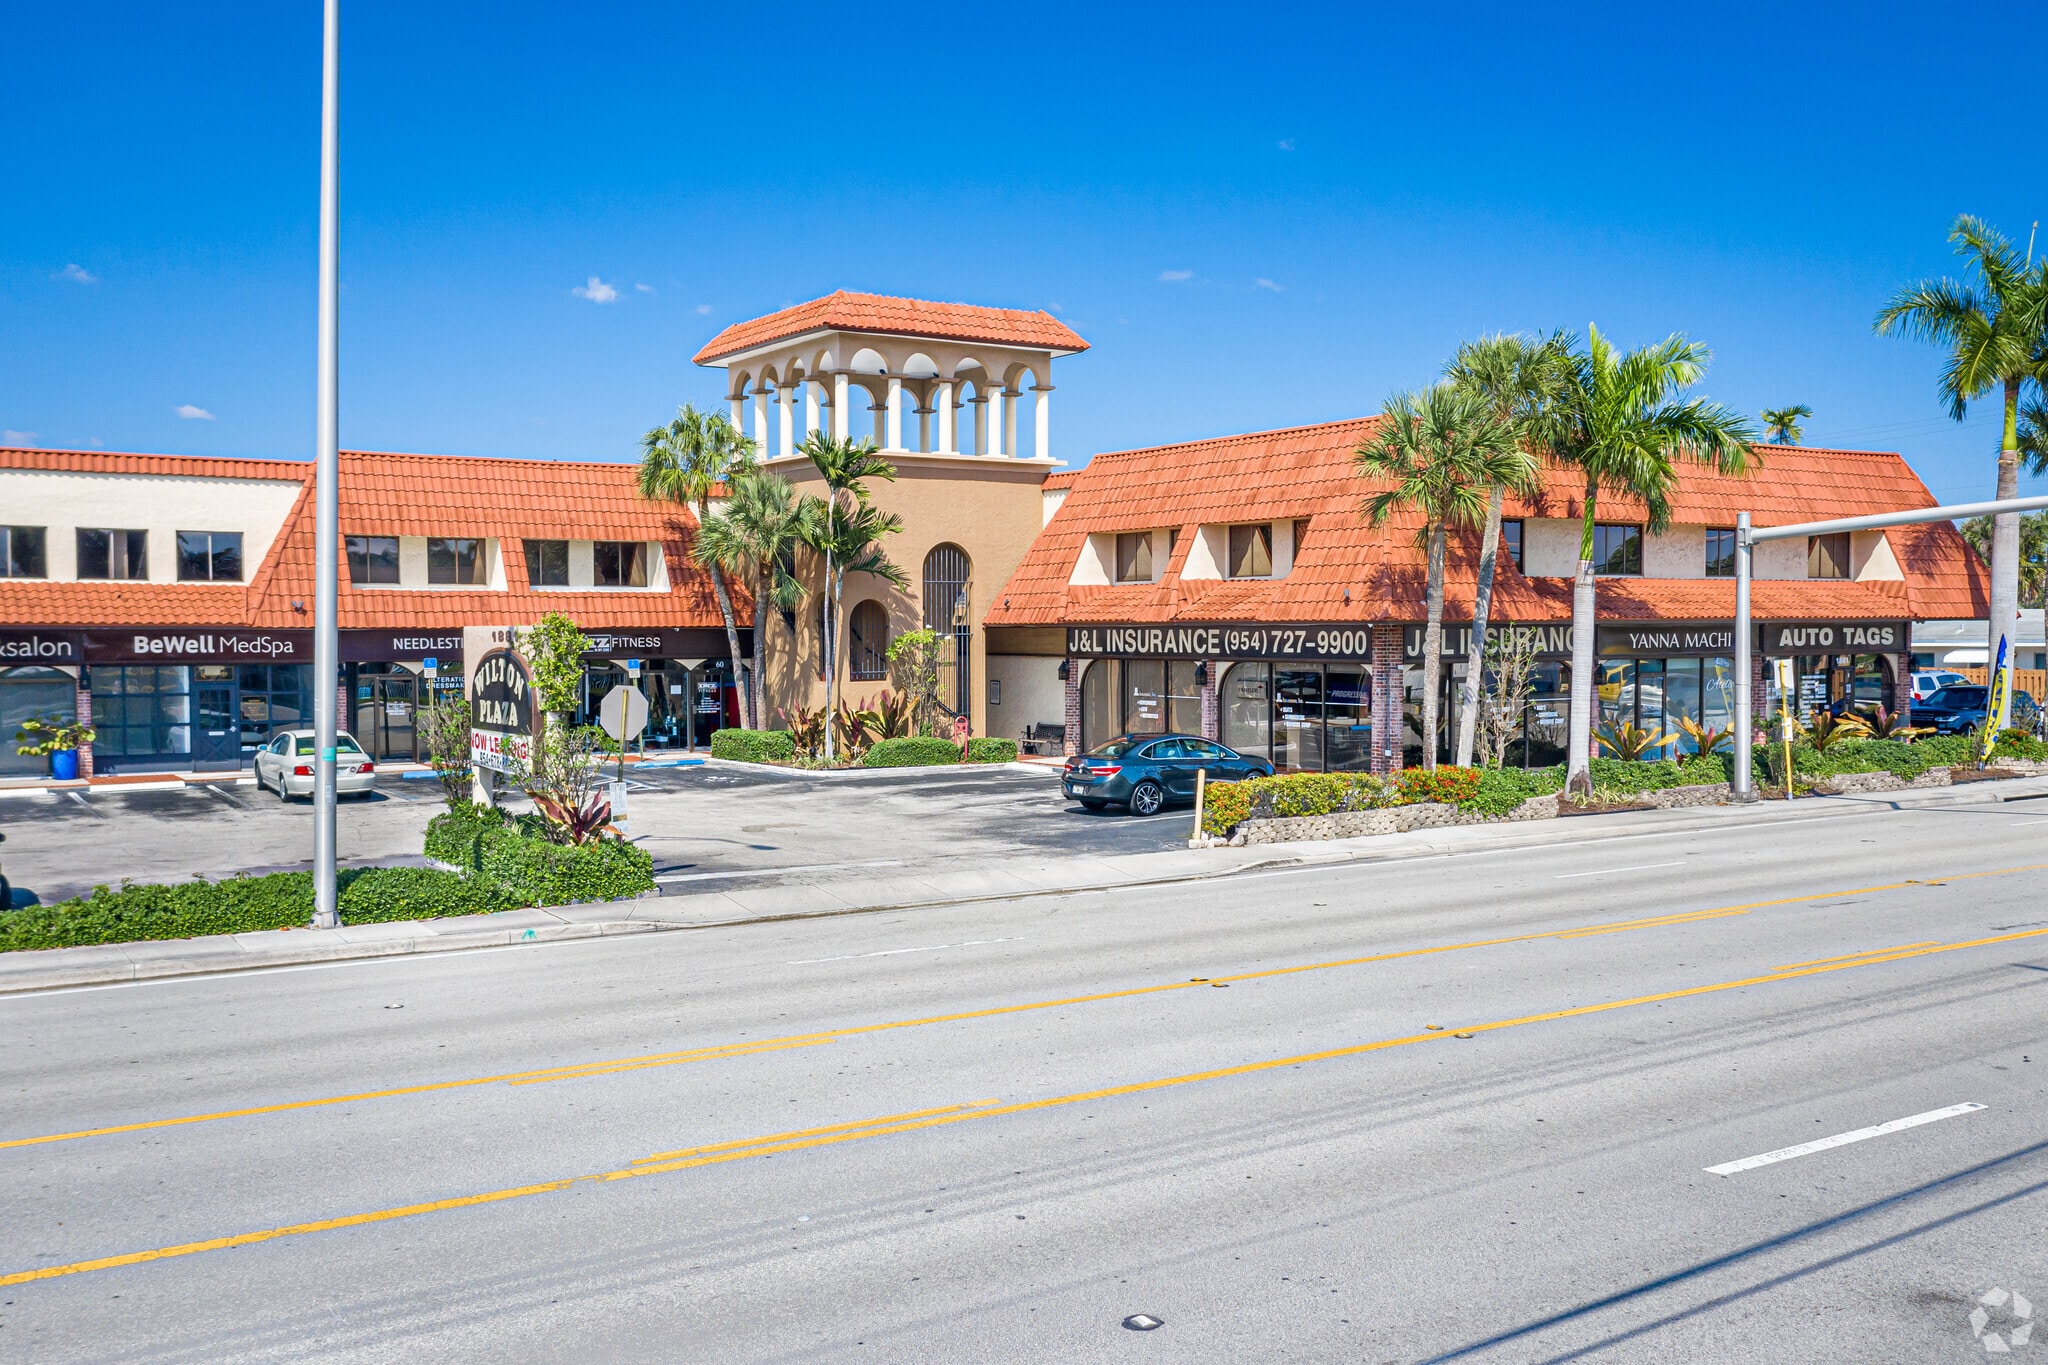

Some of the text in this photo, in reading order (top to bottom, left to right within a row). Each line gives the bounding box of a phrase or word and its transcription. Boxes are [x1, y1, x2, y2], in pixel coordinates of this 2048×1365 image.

[134, 635, 294, 658] BeWell MedSpa
[611, 637, 661, 648] FITNESS
[1069, 629, 1367, 655] J&L INSURANCE (954) 727-9900
[1407, 630, 1454, 657] JL
[1629, 632, 1732, 649] YANNA MACHI
[1779, 627, 1894, 647] AUTO TAGS
[715, 660, 725, 668] 60
[474, 658, 525, 700] WILTON
[479, 699, 519, 727] PLAZA
